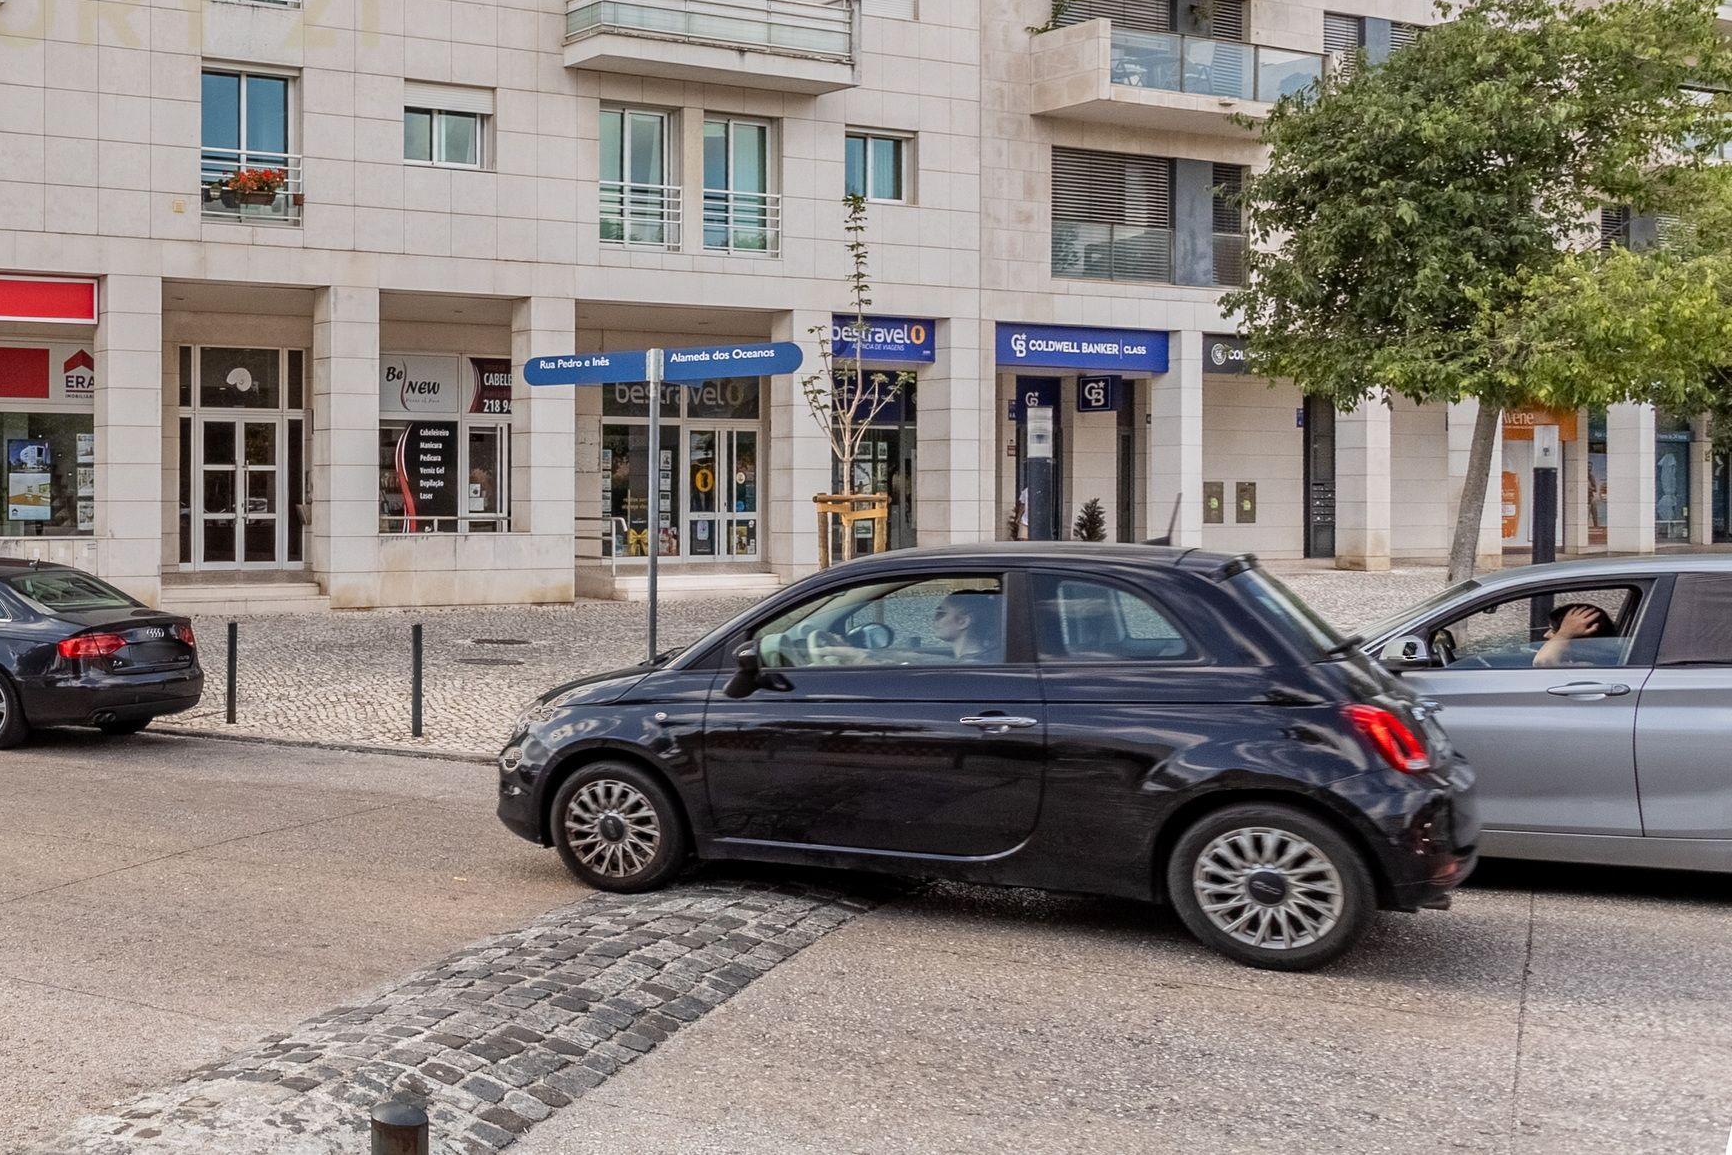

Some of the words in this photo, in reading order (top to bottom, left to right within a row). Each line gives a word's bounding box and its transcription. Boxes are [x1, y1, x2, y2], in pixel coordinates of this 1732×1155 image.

[1029, 339, 1080, 353] COLDWELL
[1082, 342, 1119, 355] BANKER
[1123, 346, 1147, 355] CLASS
[670, 351, 710, 363] Alameda
[713, 350, 729, 360] dos
[732, 348, 775, 359] Oceanos
[540, 360, 556, 370] Rua
[558, 358, 582, 369] Pedro
[592, 356, 610, 366] Inês
[386, 366, 403, 382] Be
[65, 375, 94, 389] ERA
[483, 399, 501, 413] 218
[419, 428, 450, 437] Cabeleireiro
[419, 441, 443, 449] Manicura
[436, 466, 445, 474] Gel
[419, 479, 444, 488] Depilação
[419, 492, 433, 500] Laser
